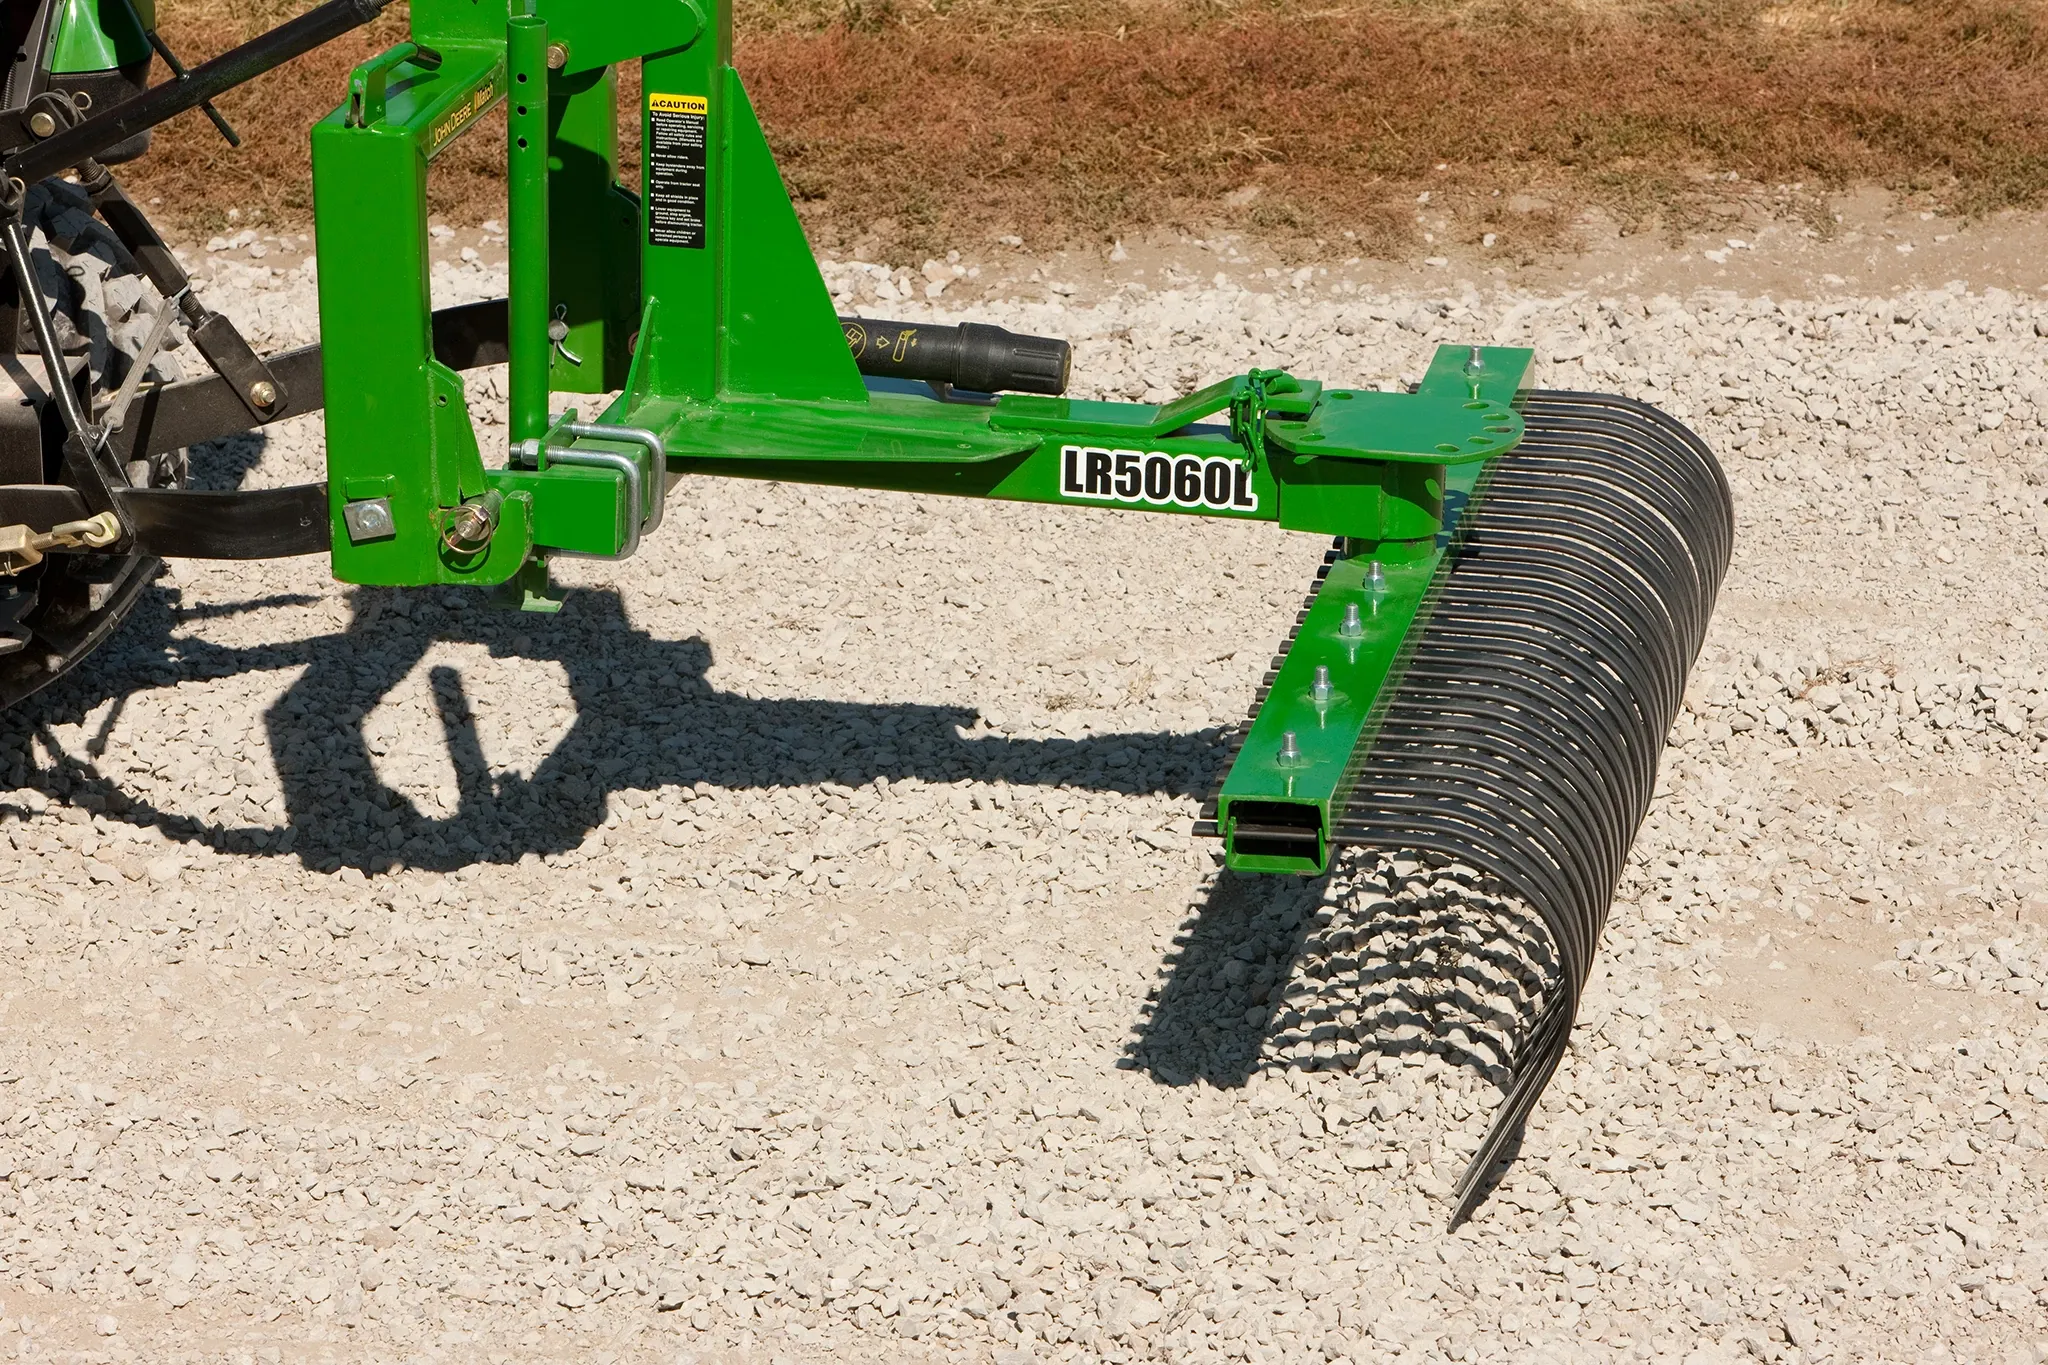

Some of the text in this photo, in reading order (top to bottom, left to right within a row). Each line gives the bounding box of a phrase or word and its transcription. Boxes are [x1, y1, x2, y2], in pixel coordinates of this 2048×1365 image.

[433, 119, 451, 147] JOHN
[450, 102, 472, 131] DEERE
[660, 100, 704, 110] CAUTION
[1064, 449, 1254, 507] LR5060L
